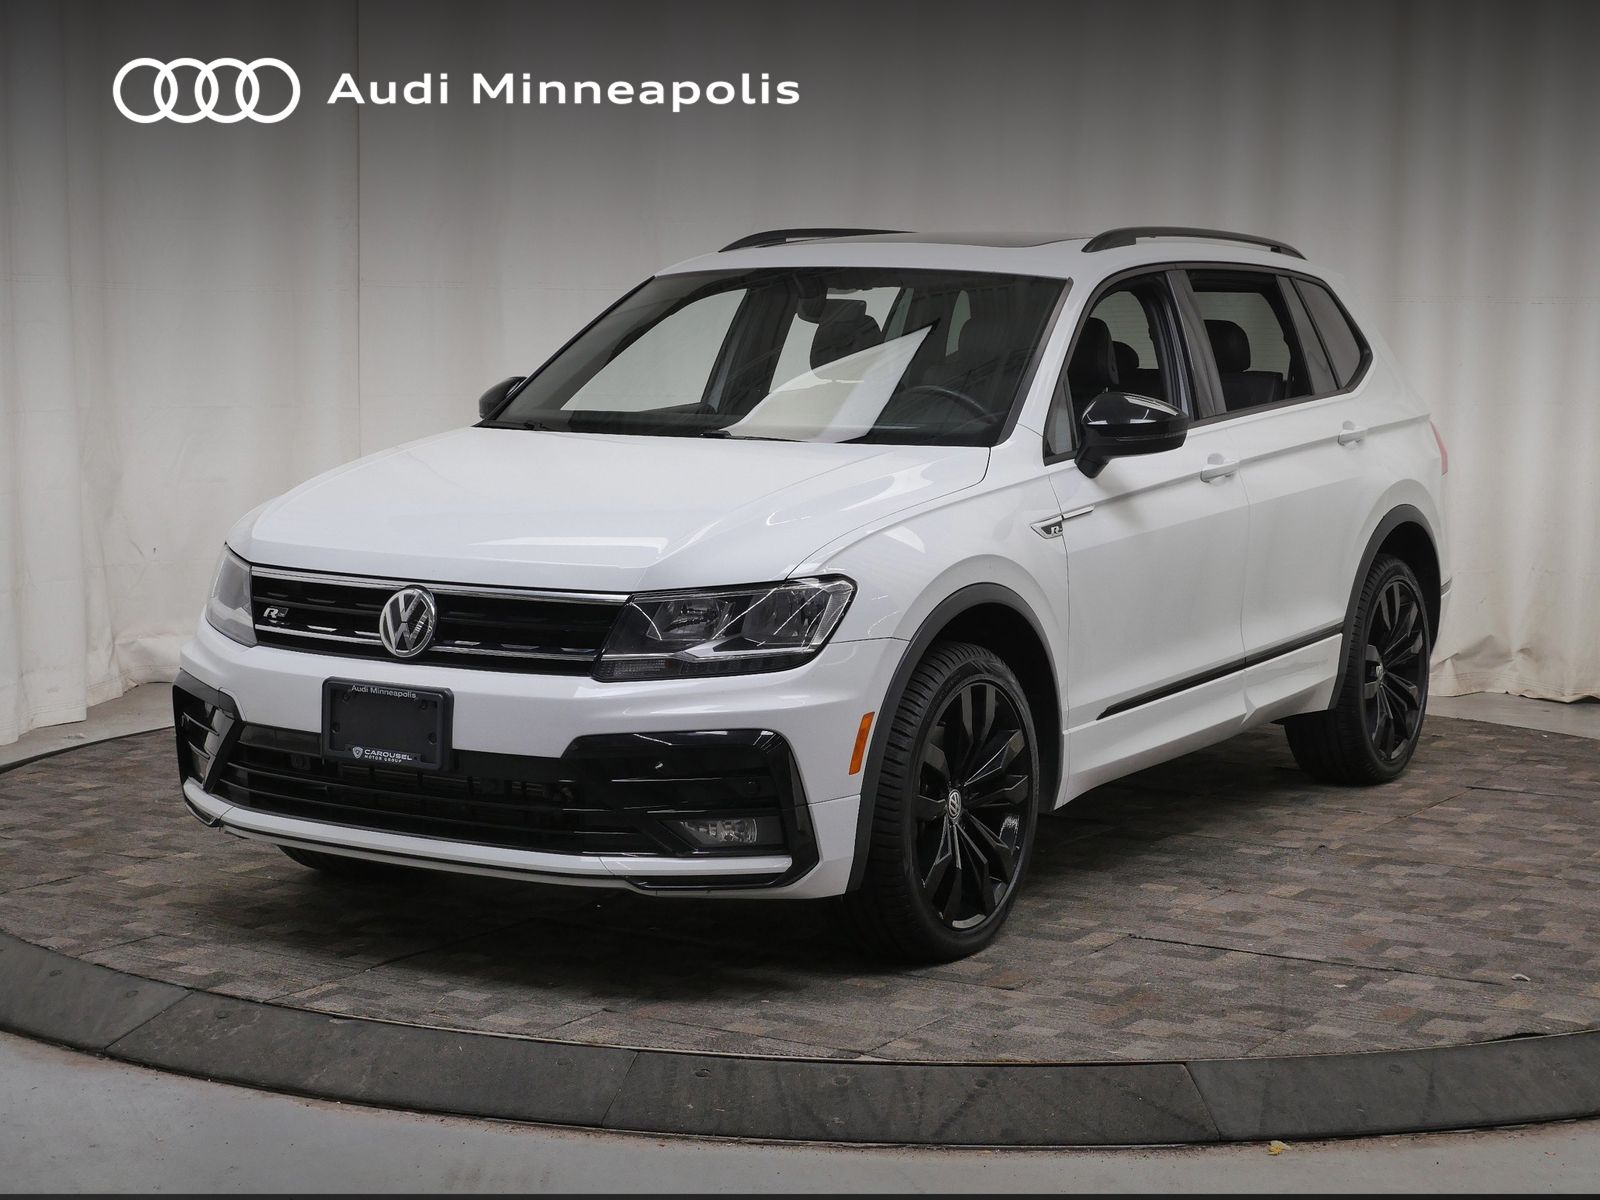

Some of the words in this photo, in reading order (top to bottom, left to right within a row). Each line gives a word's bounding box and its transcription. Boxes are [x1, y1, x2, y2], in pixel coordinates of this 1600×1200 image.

[351, 684, 369, 693] Audi
[370, 687, 417, 699] Minneapolis
[364, 749, 413, 761] CAROUSEL
